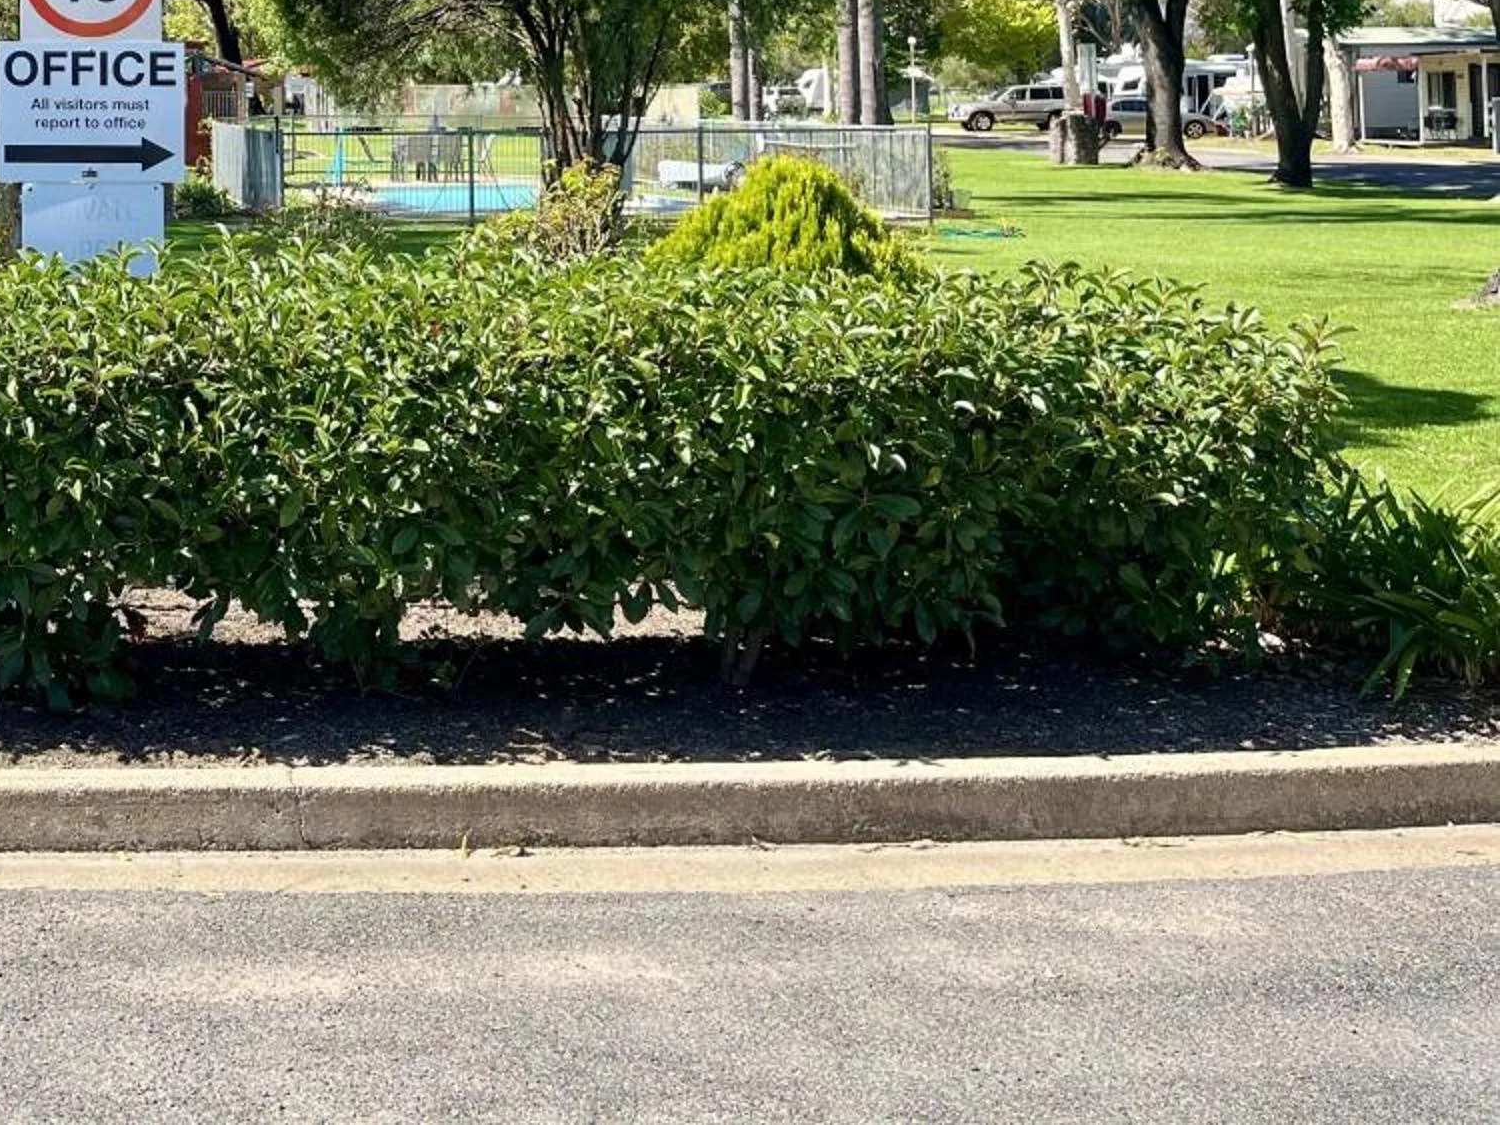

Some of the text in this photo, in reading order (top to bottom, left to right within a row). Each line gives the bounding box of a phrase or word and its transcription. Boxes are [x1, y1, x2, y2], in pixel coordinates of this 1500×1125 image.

[4, 49, 177, 88] OFFICE
[30, 97, 150, 112] All visitors must
[34, 116, 147, 133] report to office
